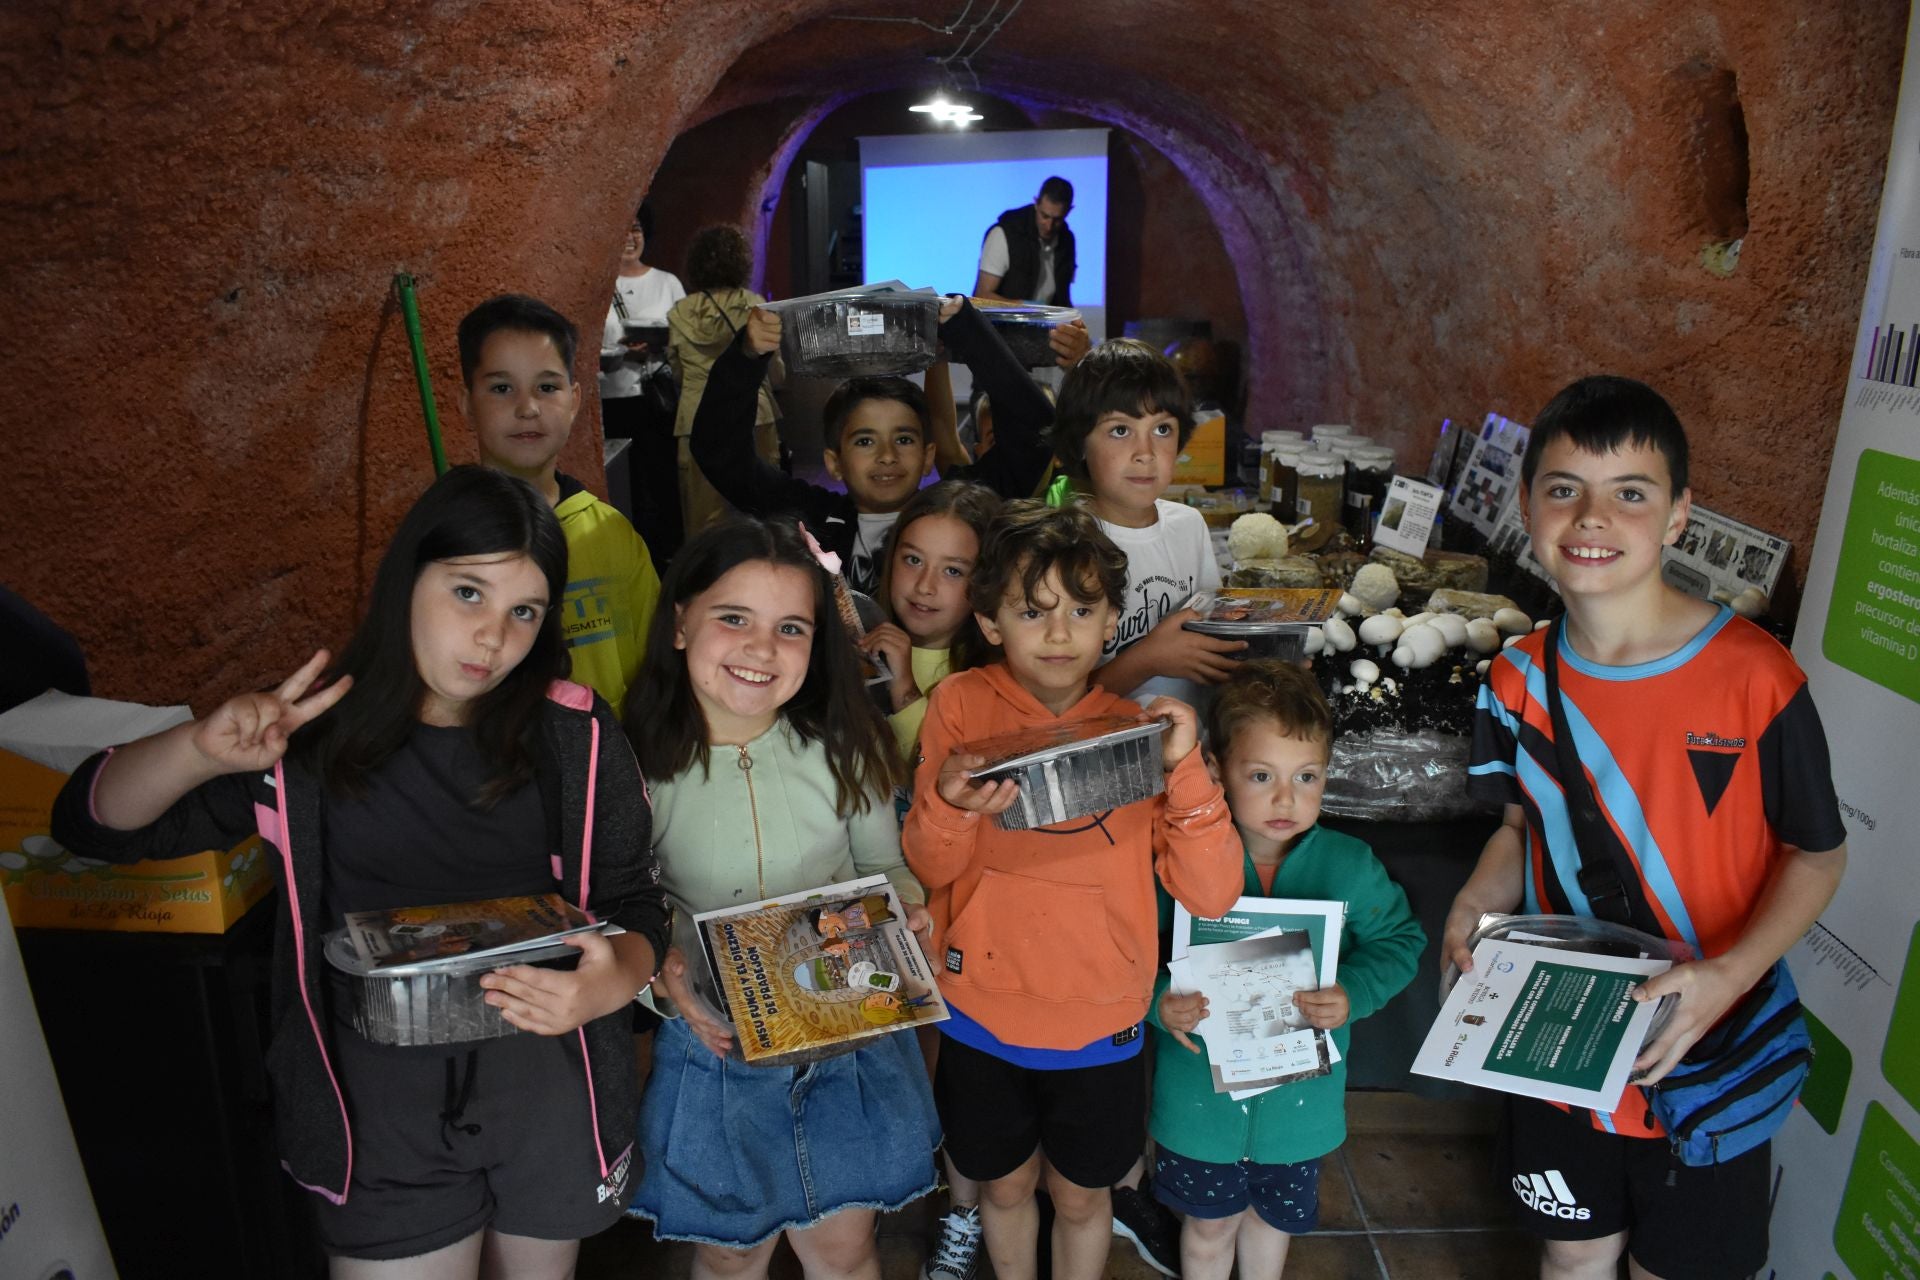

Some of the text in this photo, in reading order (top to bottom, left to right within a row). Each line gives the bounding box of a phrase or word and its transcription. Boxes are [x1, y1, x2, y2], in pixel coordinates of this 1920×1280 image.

[1877, 481, 1919, 505] Además
[1871, 528, 1917, 557] hortaliza
[1142, 576, 1155, 586] WAVE
[1155, 576, 1177, 588] PRODUCT
[1855, 600, 1920, 637] precursor de
[1860, 626, 1918, 661] vitamina D
[1839, 800, 1876, 831] (mg/100g)
[160, 882, 212, 902] Setas
[119, 902, 174, 924] Rioja
[1223, 916, 1250, 925] FUNGI
[724, 923, 743, 962] DIEZMO
[736, 965, 747, 975] EL
[746, 945, 778, 1015] DE PRADEJÓN
[1540, 974, 1552, 985] ESTE
[1533, 986, 1545, 999] LIBRO
[1581, 975, 1597, 996] ANTONIO
[744, 985, 762, 1018] FUNGI
[1521, 1000, 1538, 1022] CONTIENE
[1570, 1003, 1583, 1020] BENITO
[1611, 1001, 1627, 1022] FUNGI
[1494, 969, 1545, 1059] LECTURA CON ACTIVIDADES DIDÁCTICAS
[754, 1018, 772, 1049] ANSU
[1507, 1031, 1522, 1049] TALLER
[1452, 1042, 1463, 1050] La
[1442, 1050, 1459, 1067] Rioja
[1512, 1176, 1592, 1221] adidas
